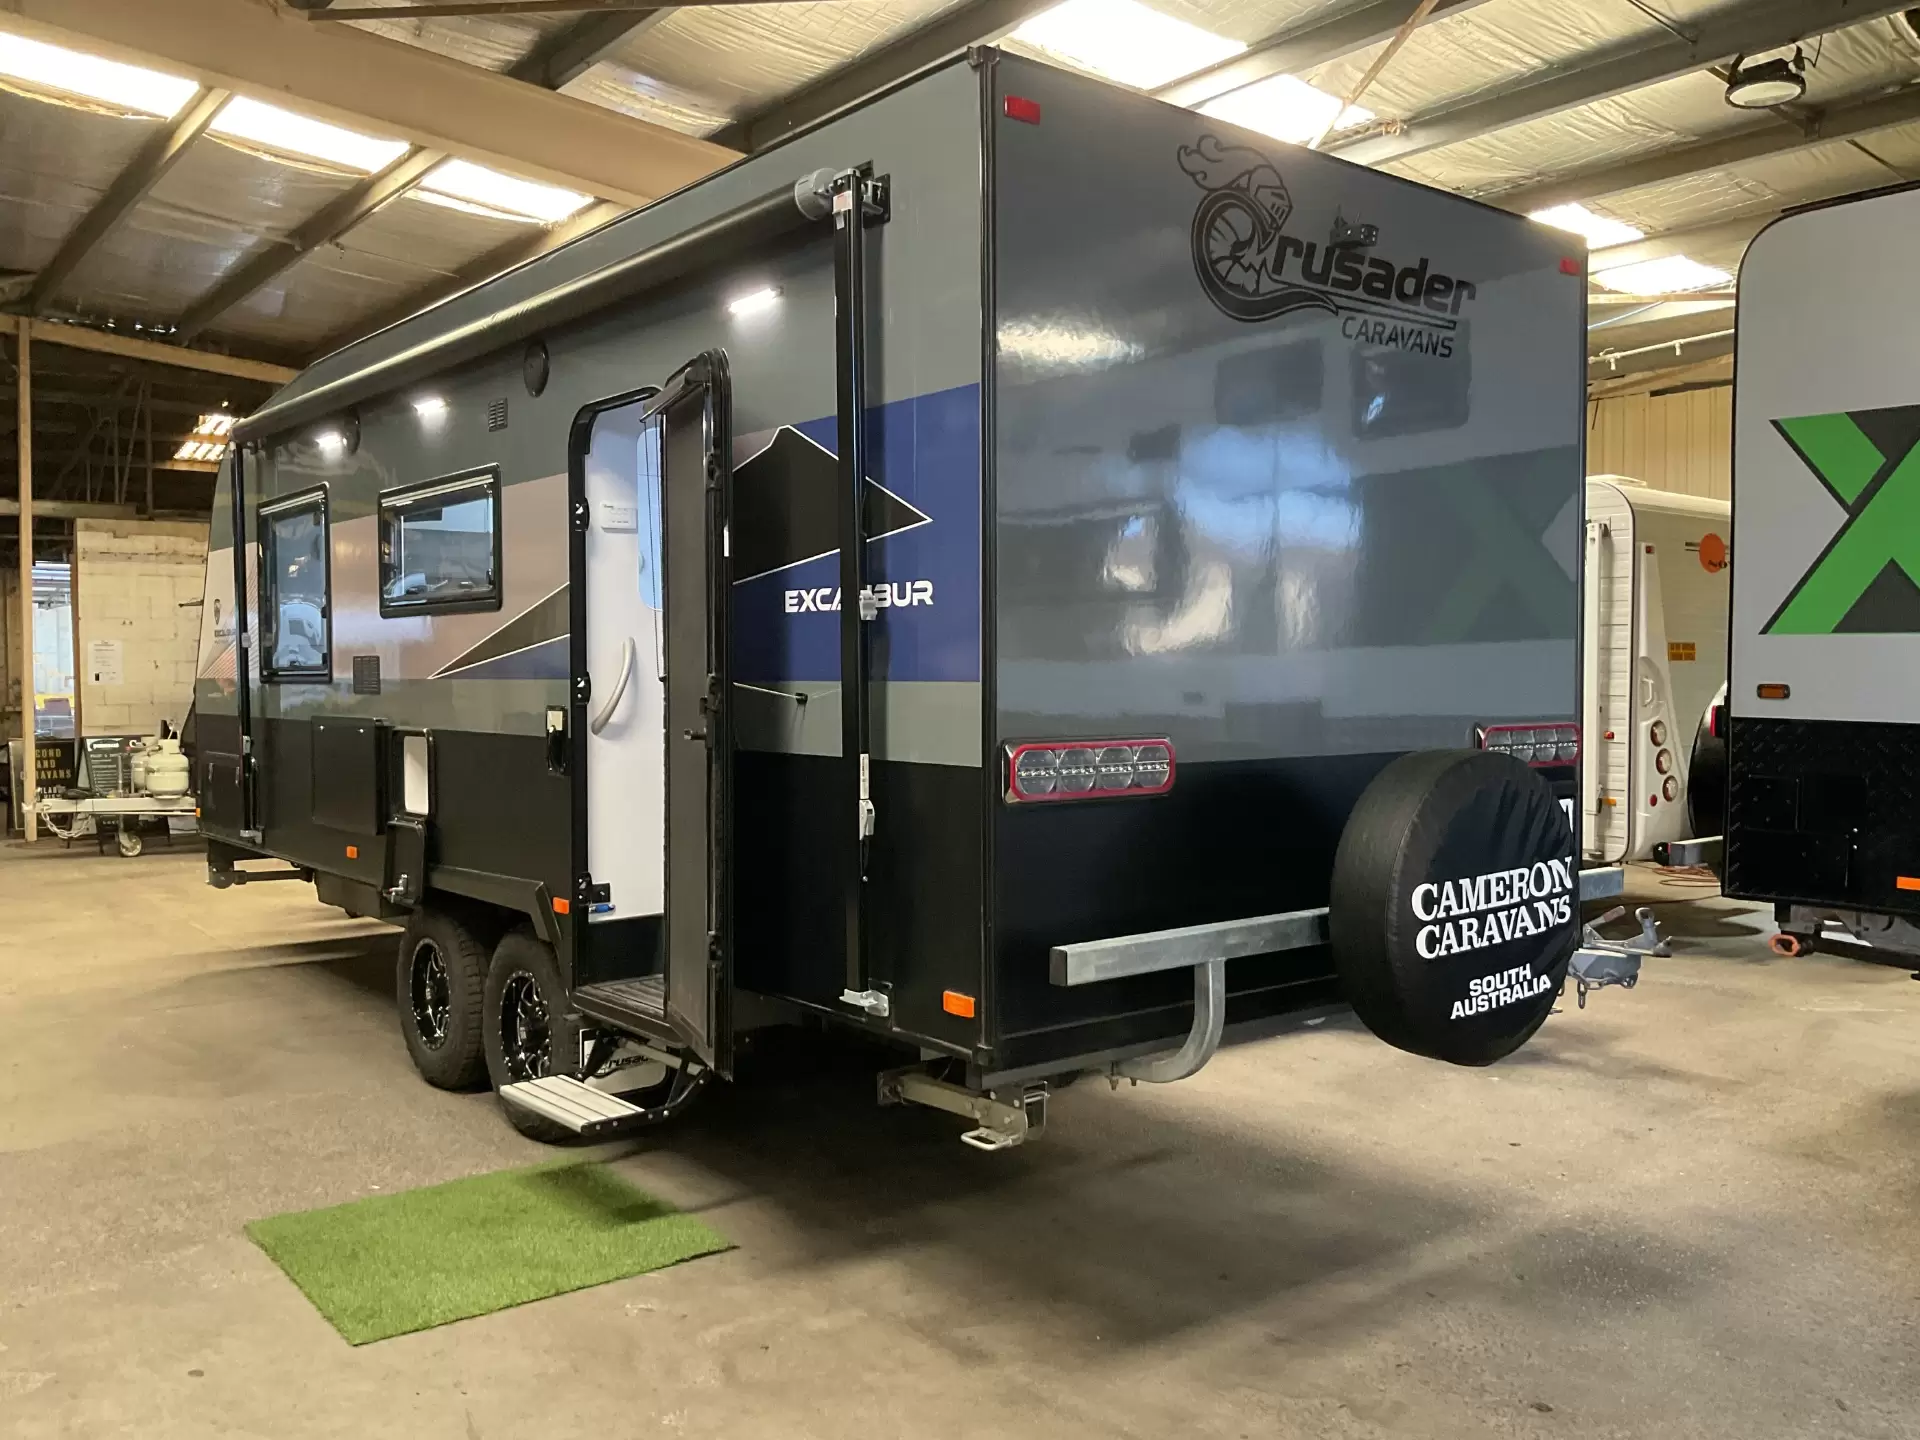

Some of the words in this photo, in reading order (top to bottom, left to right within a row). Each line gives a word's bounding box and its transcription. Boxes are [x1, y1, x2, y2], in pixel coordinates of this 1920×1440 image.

[1342, 316, 1454, 358] CARAVANS
[785, 580, 933, 613] EXCBUR
[35, 749, 61, 757] COND
[37, 760, 56, 768] AND
[20, 769, 71, 780] CAVANS
[1412, 856, 1573, 921] CAMERON
[1415, 894, 1572, 960] CARAVANS
[1450, 974, 1552, 1020] AUSTRALIA
[1469, 963, 1532, 997] SOUTH
